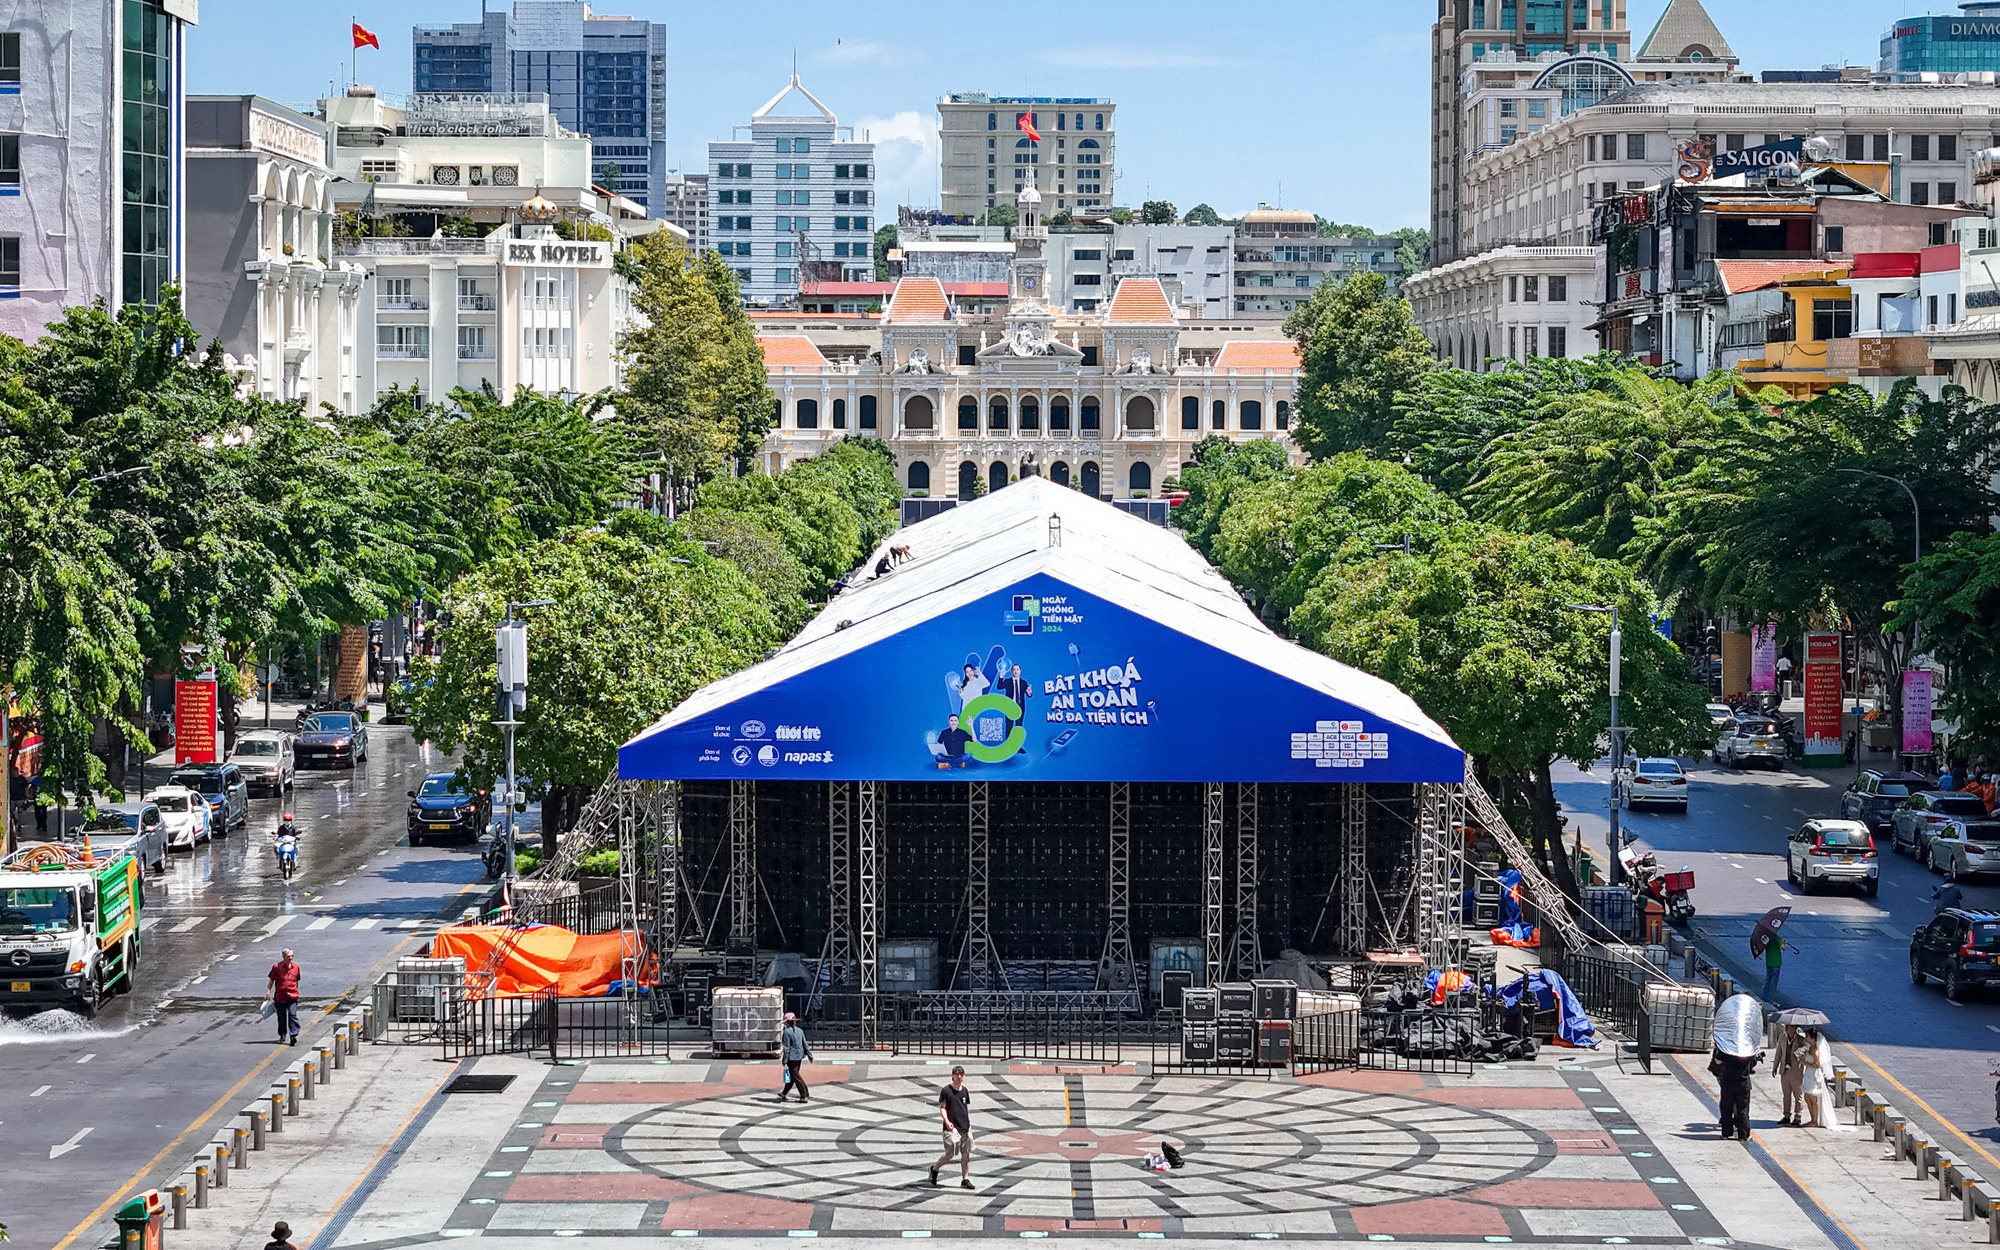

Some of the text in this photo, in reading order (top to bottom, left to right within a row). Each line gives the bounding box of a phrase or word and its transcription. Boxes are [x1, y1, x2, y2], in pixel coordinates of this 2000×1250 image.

[1726, 150, 1799, 166] SAIGON
[1745, 168, 1799, 178] CHILL
[508, 244, 603, 261] REX HOTEL
[1042, 595, 1067, 604] NGÀY
[1042, 604, 1074, 613] KHÔNG
[1064, 614, 1083, 625] MẶT
[1044, 656, 1142, 696] BẬT KHOÁ
[1051, 685, 1138, 709] AN TOÀN
[1046, 708, 1149, 726] MỞ ĐA TIỆN ÍCH
[784, 752, 822, 765] napas
